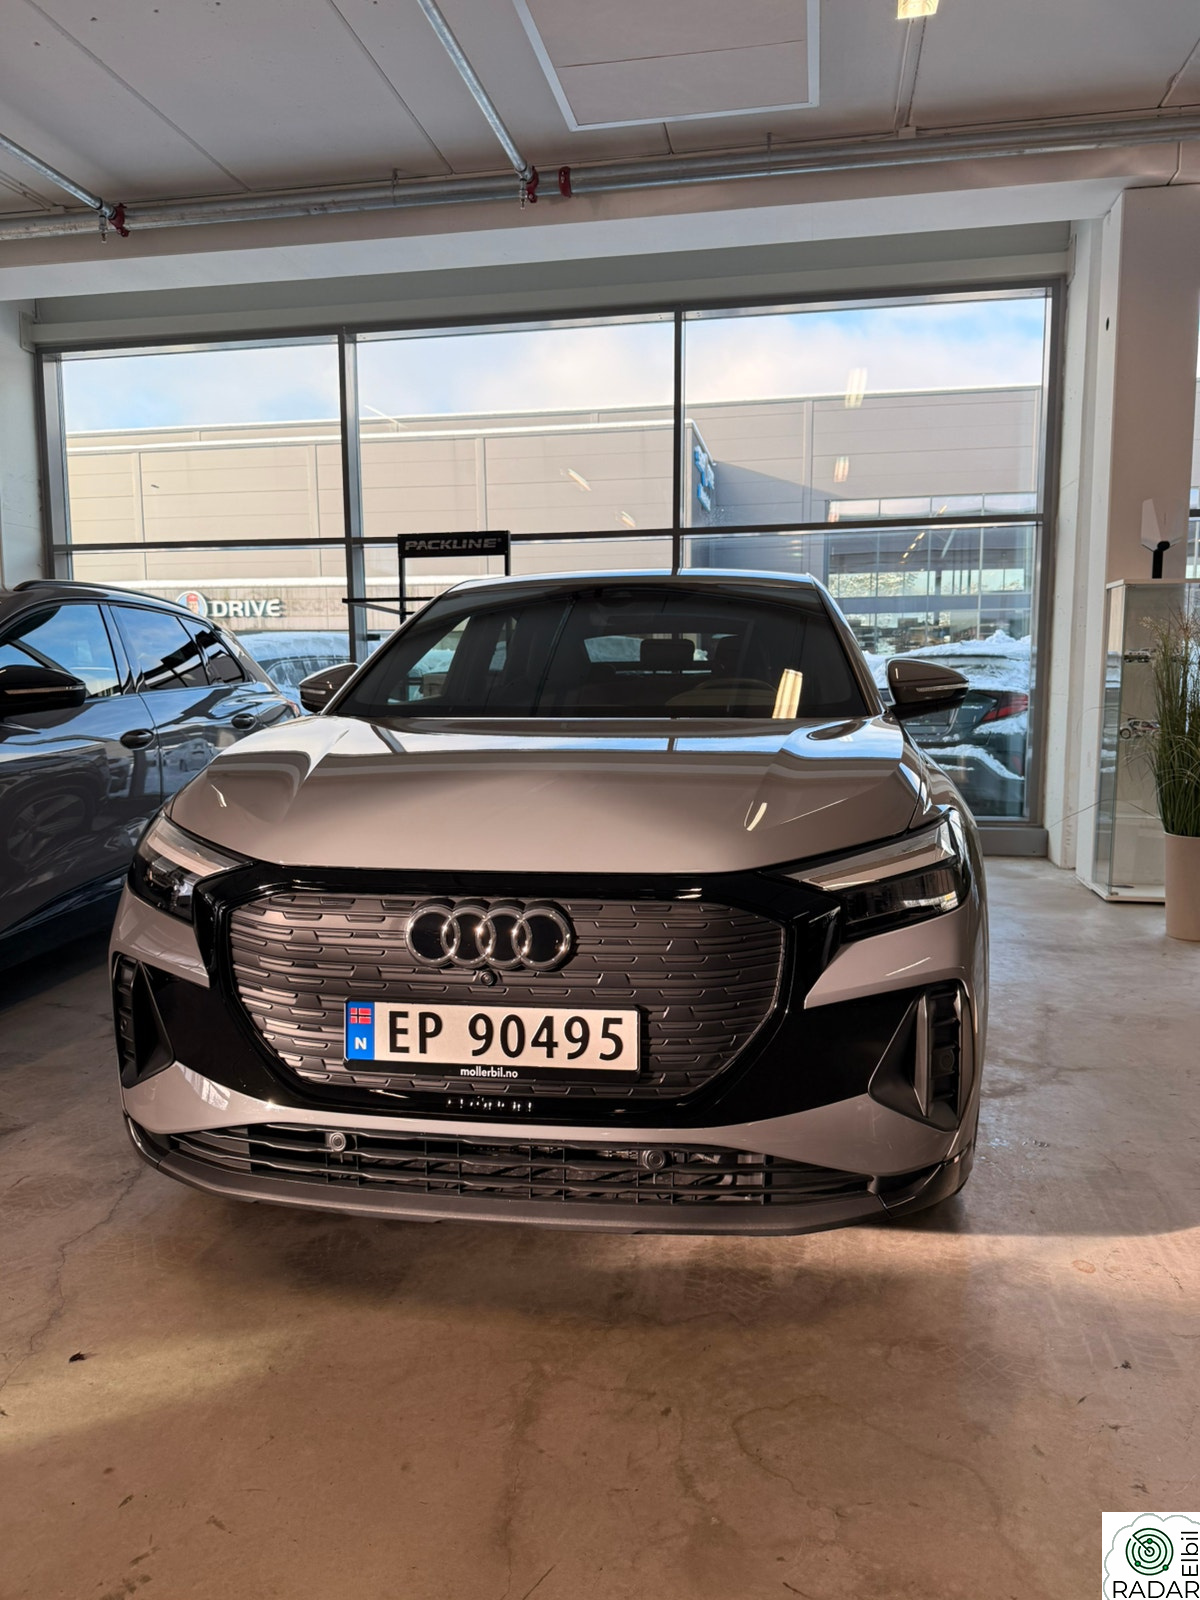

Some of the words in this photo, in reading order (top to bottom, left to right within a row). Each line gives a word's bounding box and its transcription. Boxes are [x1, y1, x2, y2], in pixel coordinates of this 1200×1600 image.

[211, 599, 281, 617] DRIVE
[388, 1010, 443, 1054] EP
[468, 1013, 624, 1061] 90495
[354, 1037, 368, 1050] N
[460, 1067, 518, 1079] mollerbil.no
